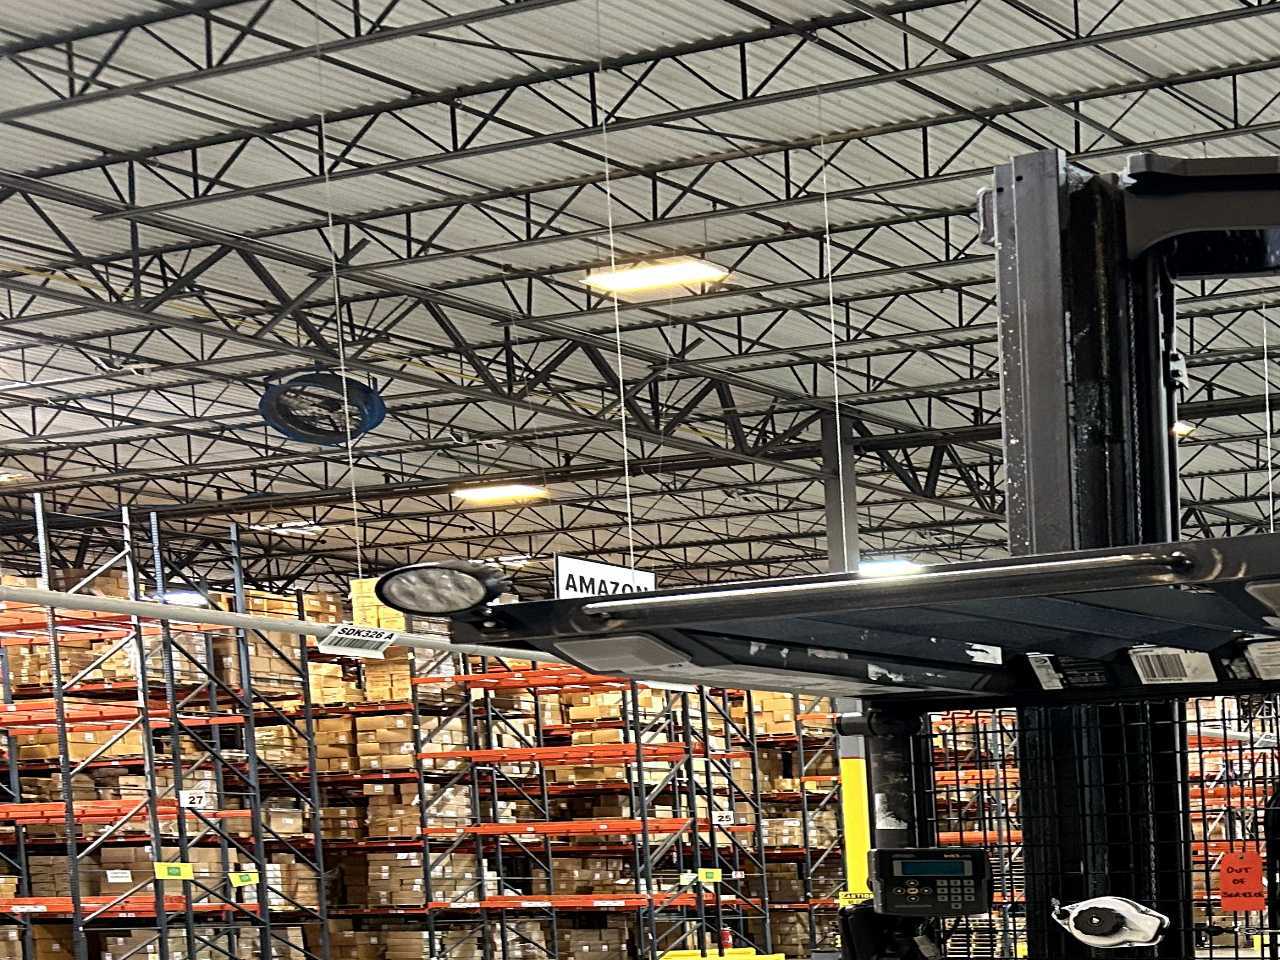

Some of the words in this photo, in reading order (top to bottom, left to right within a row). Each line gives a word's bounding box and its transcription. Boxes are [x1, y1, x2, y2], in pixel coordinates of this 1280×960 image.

[337, 627, 385, 639] SDK326
[384, 632, 394, 640] A
[188, 795, 203, 805] 27
